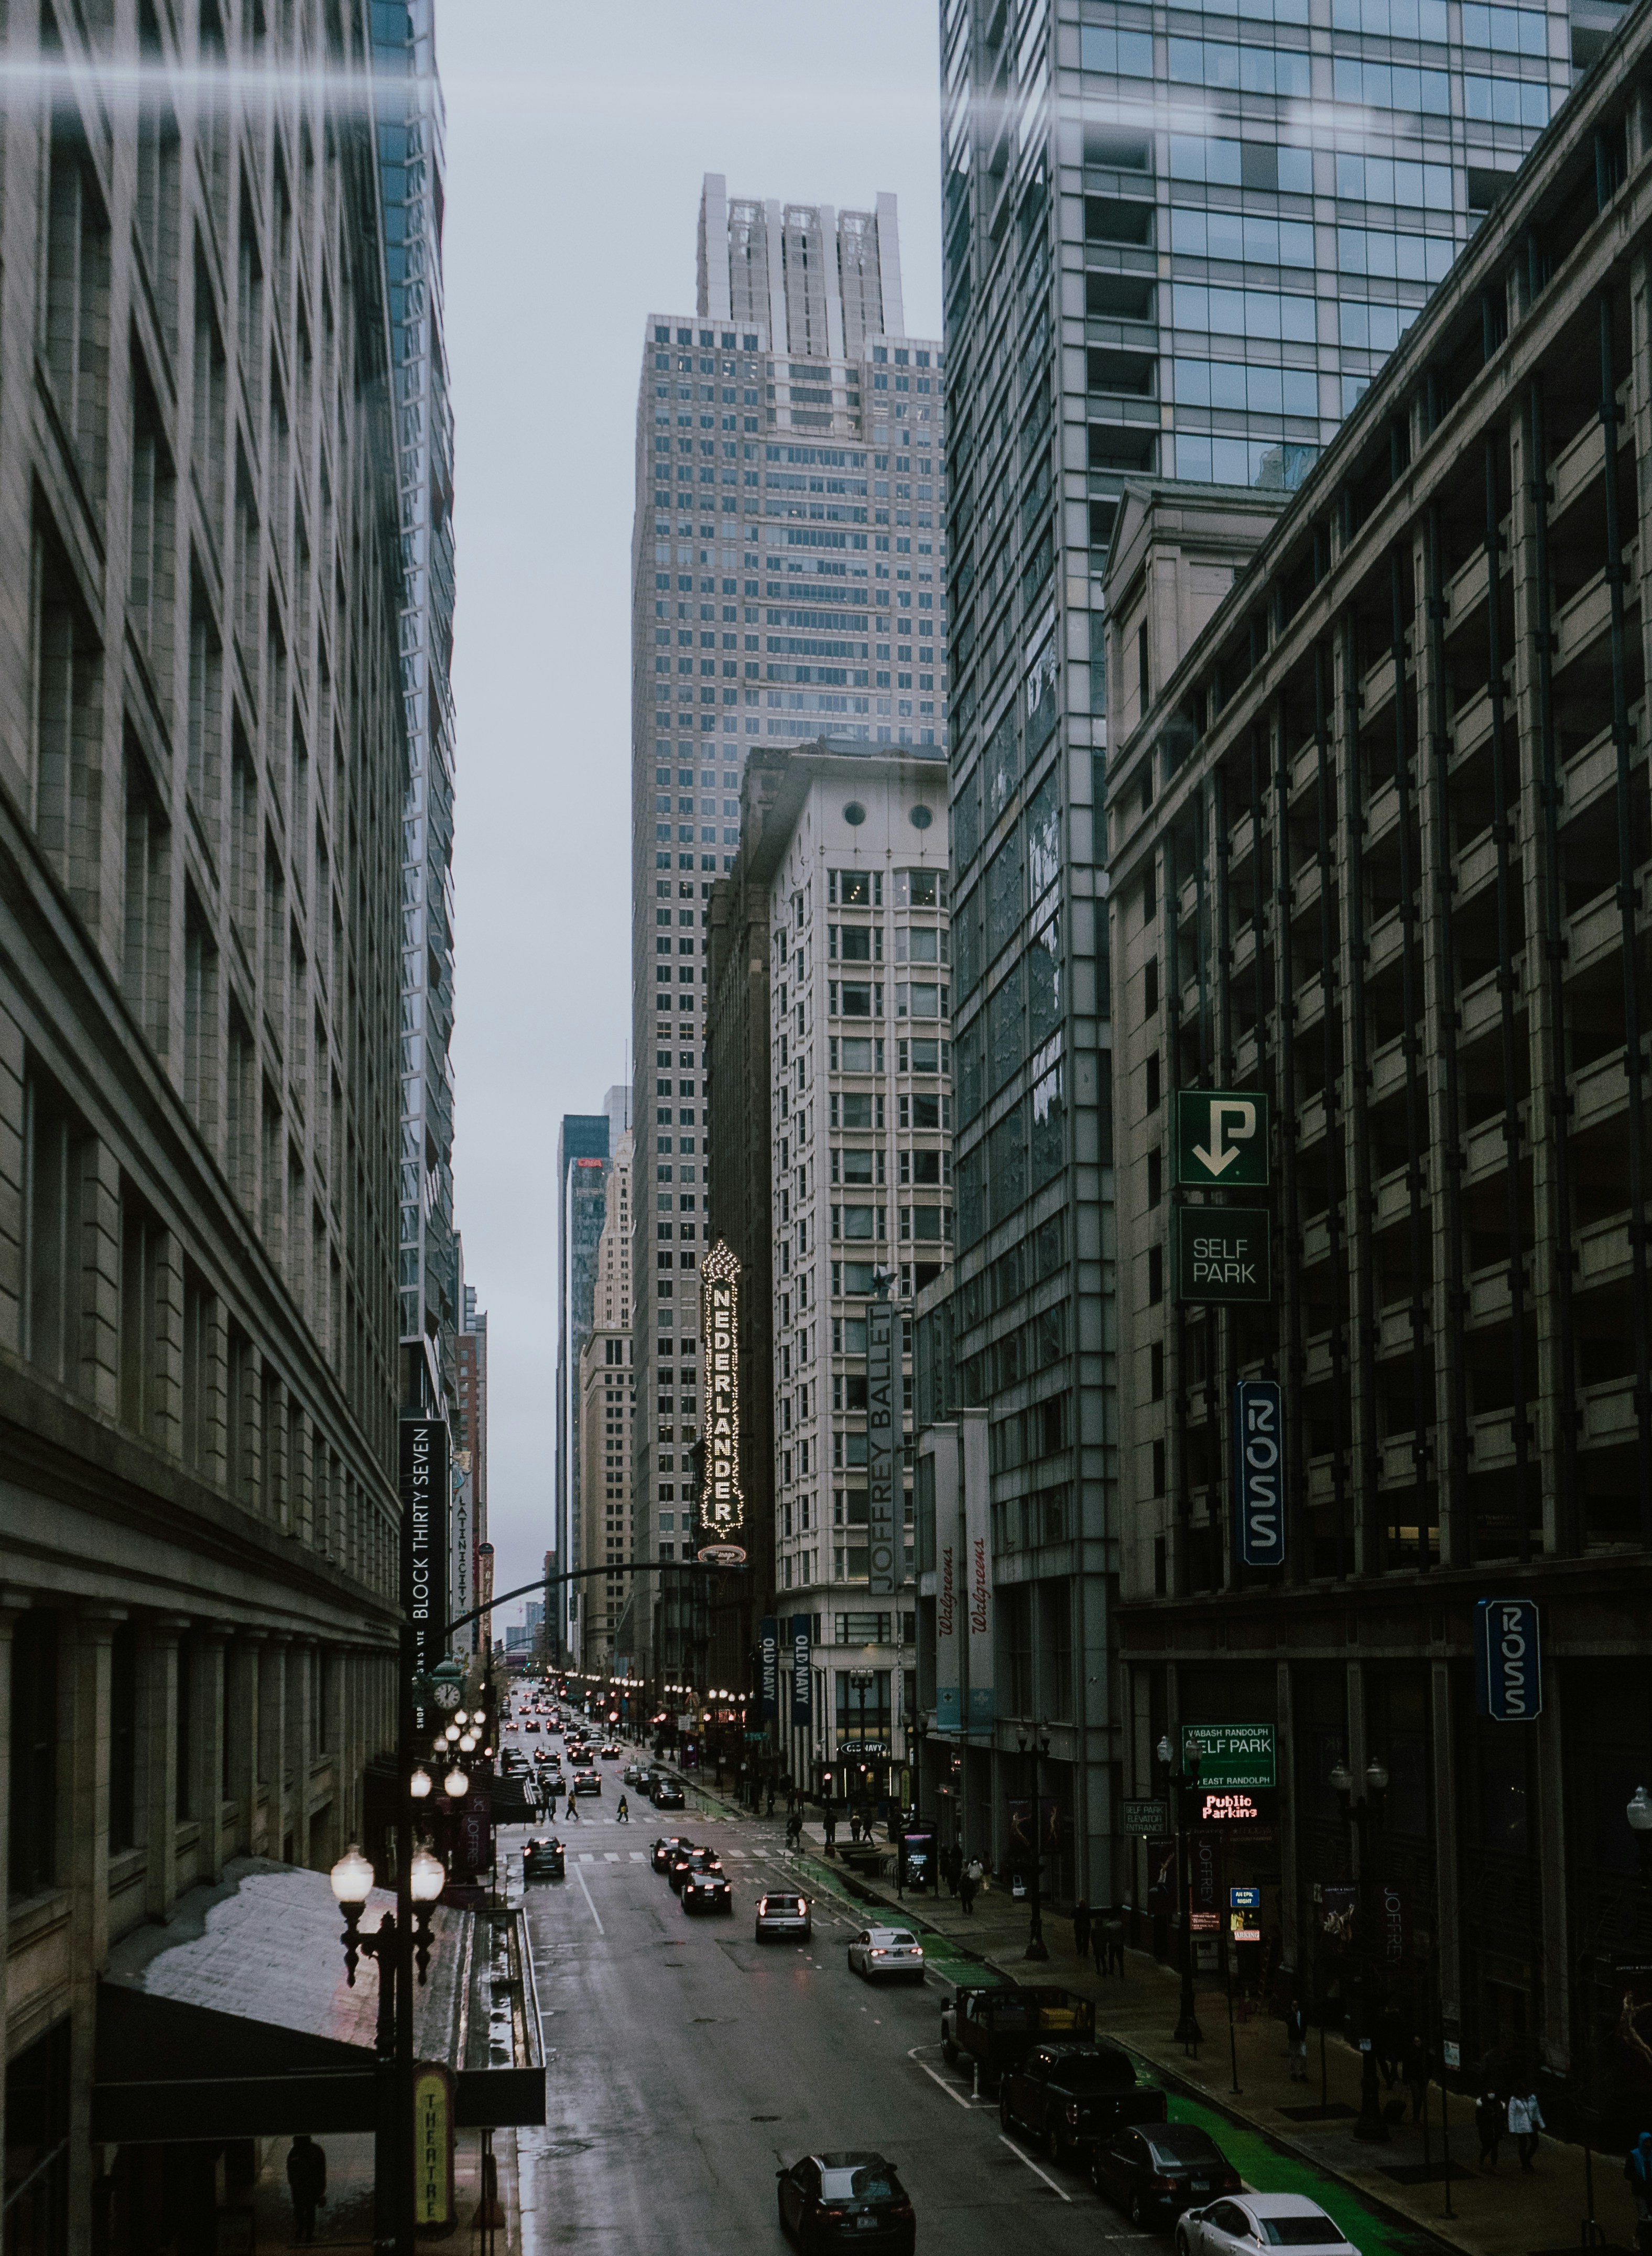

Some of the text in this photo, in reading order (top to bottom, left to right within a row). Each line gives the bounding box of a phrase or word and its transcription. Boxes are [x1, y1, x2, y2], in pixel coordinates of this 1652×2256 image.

[1193, 1238, 1248, 1259] SELF
[1193, 1263, 1256, 1284] PARK
[714, 1289, 732, 1521] NEDERLANDER
[870, 1308, 893, 1591] JOFFREY BALLET
[1246, 1399, 1278, 1549] ROSS
[413, 1429, 429, 1619] BLOCK THIRTY SEVEN
[456, 1496, 468, 1606] LATINICITY
[938, 1546, 958, 1637] Walgreens
[972, 1536, 991, 1634] Walgreens
[762, 1638, 775, 1702] OLD NAVY
[795, 1634, 809, 1705] OLD NAVY
[1502, 1607, 1526, 1715] ROSS
[1188, 1728, 1268, 1738] WABASH RANDOLPH
[1230, 1739, 1271, 1753] PARK
[1202, 1806, 1257, 1819] Parking
[1206, 1795, 1252, 1808] Public
[1226, 1777, 1270, 1785] RANDOLPH
[468, 1817, 479, 1868] JOFFREY
[1199, 1840, 1214, 1905] JOFFREY
[1384, 1887, 1402, 1967] JOFFREY
[425, 2094, 437, 2217] THEATRE
